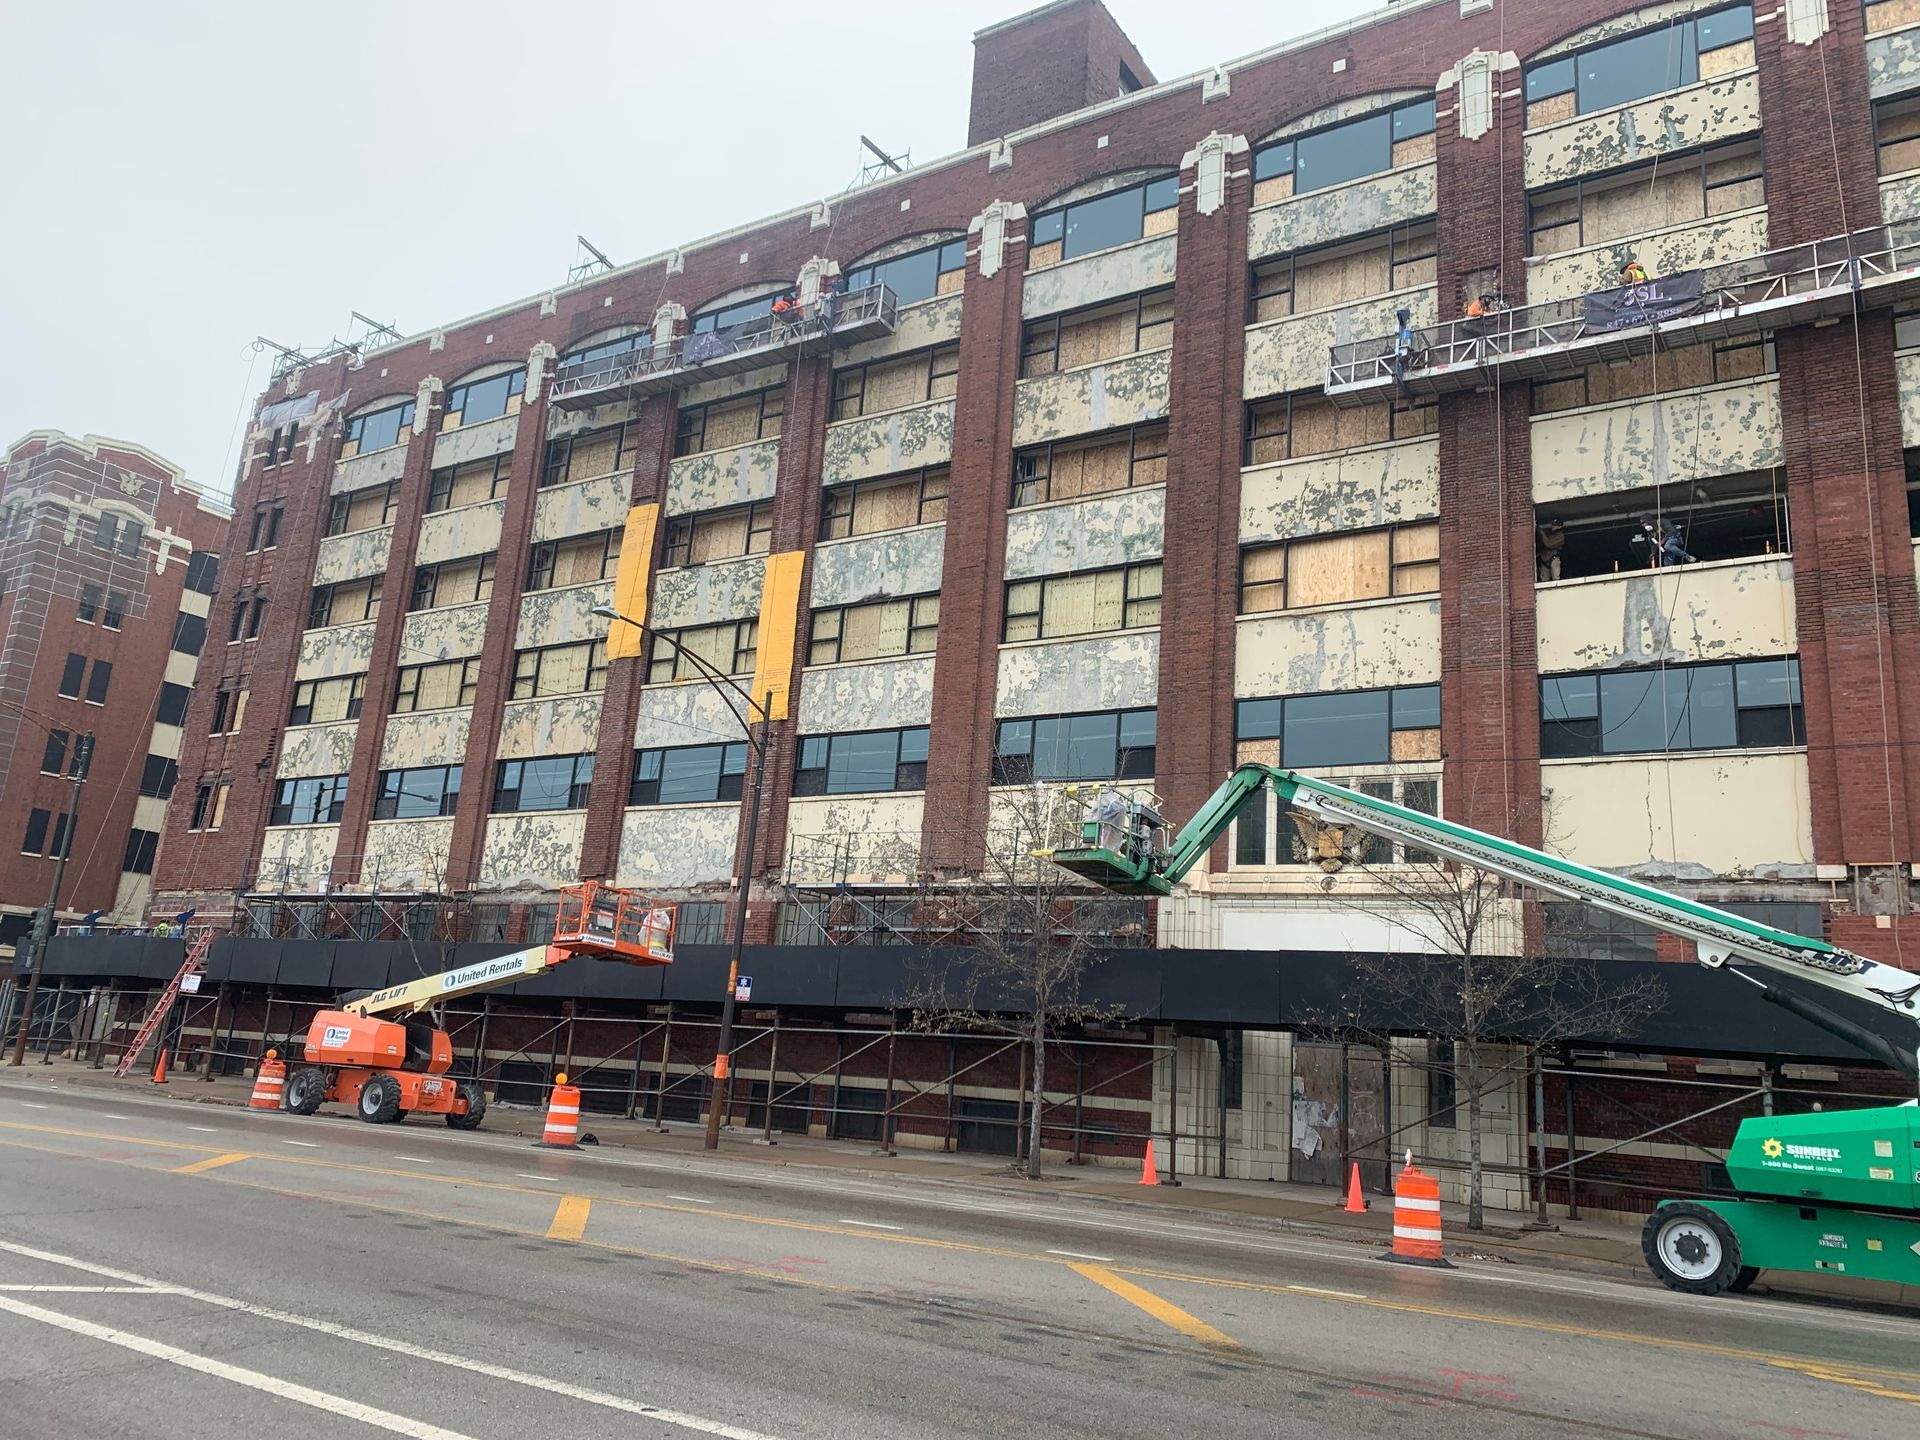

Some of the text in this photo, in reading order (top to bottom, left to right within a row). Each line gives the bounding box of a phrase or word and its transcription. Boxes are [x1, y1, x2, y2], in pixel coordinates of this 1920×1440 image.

[457, 957, 523, 984] United Rentals
[371, 986, 409, 1004] JLG LIFT
[1786, 1144, 1840, 1158] SUNBELT
[1793, 1154, 1833, 1162] RENTALS
[1761, 1160, 1781, 1168] 1-800
[1782, 1161, 1792, 1169] No
[1793, 1162, 1815, 1171] Sweat
